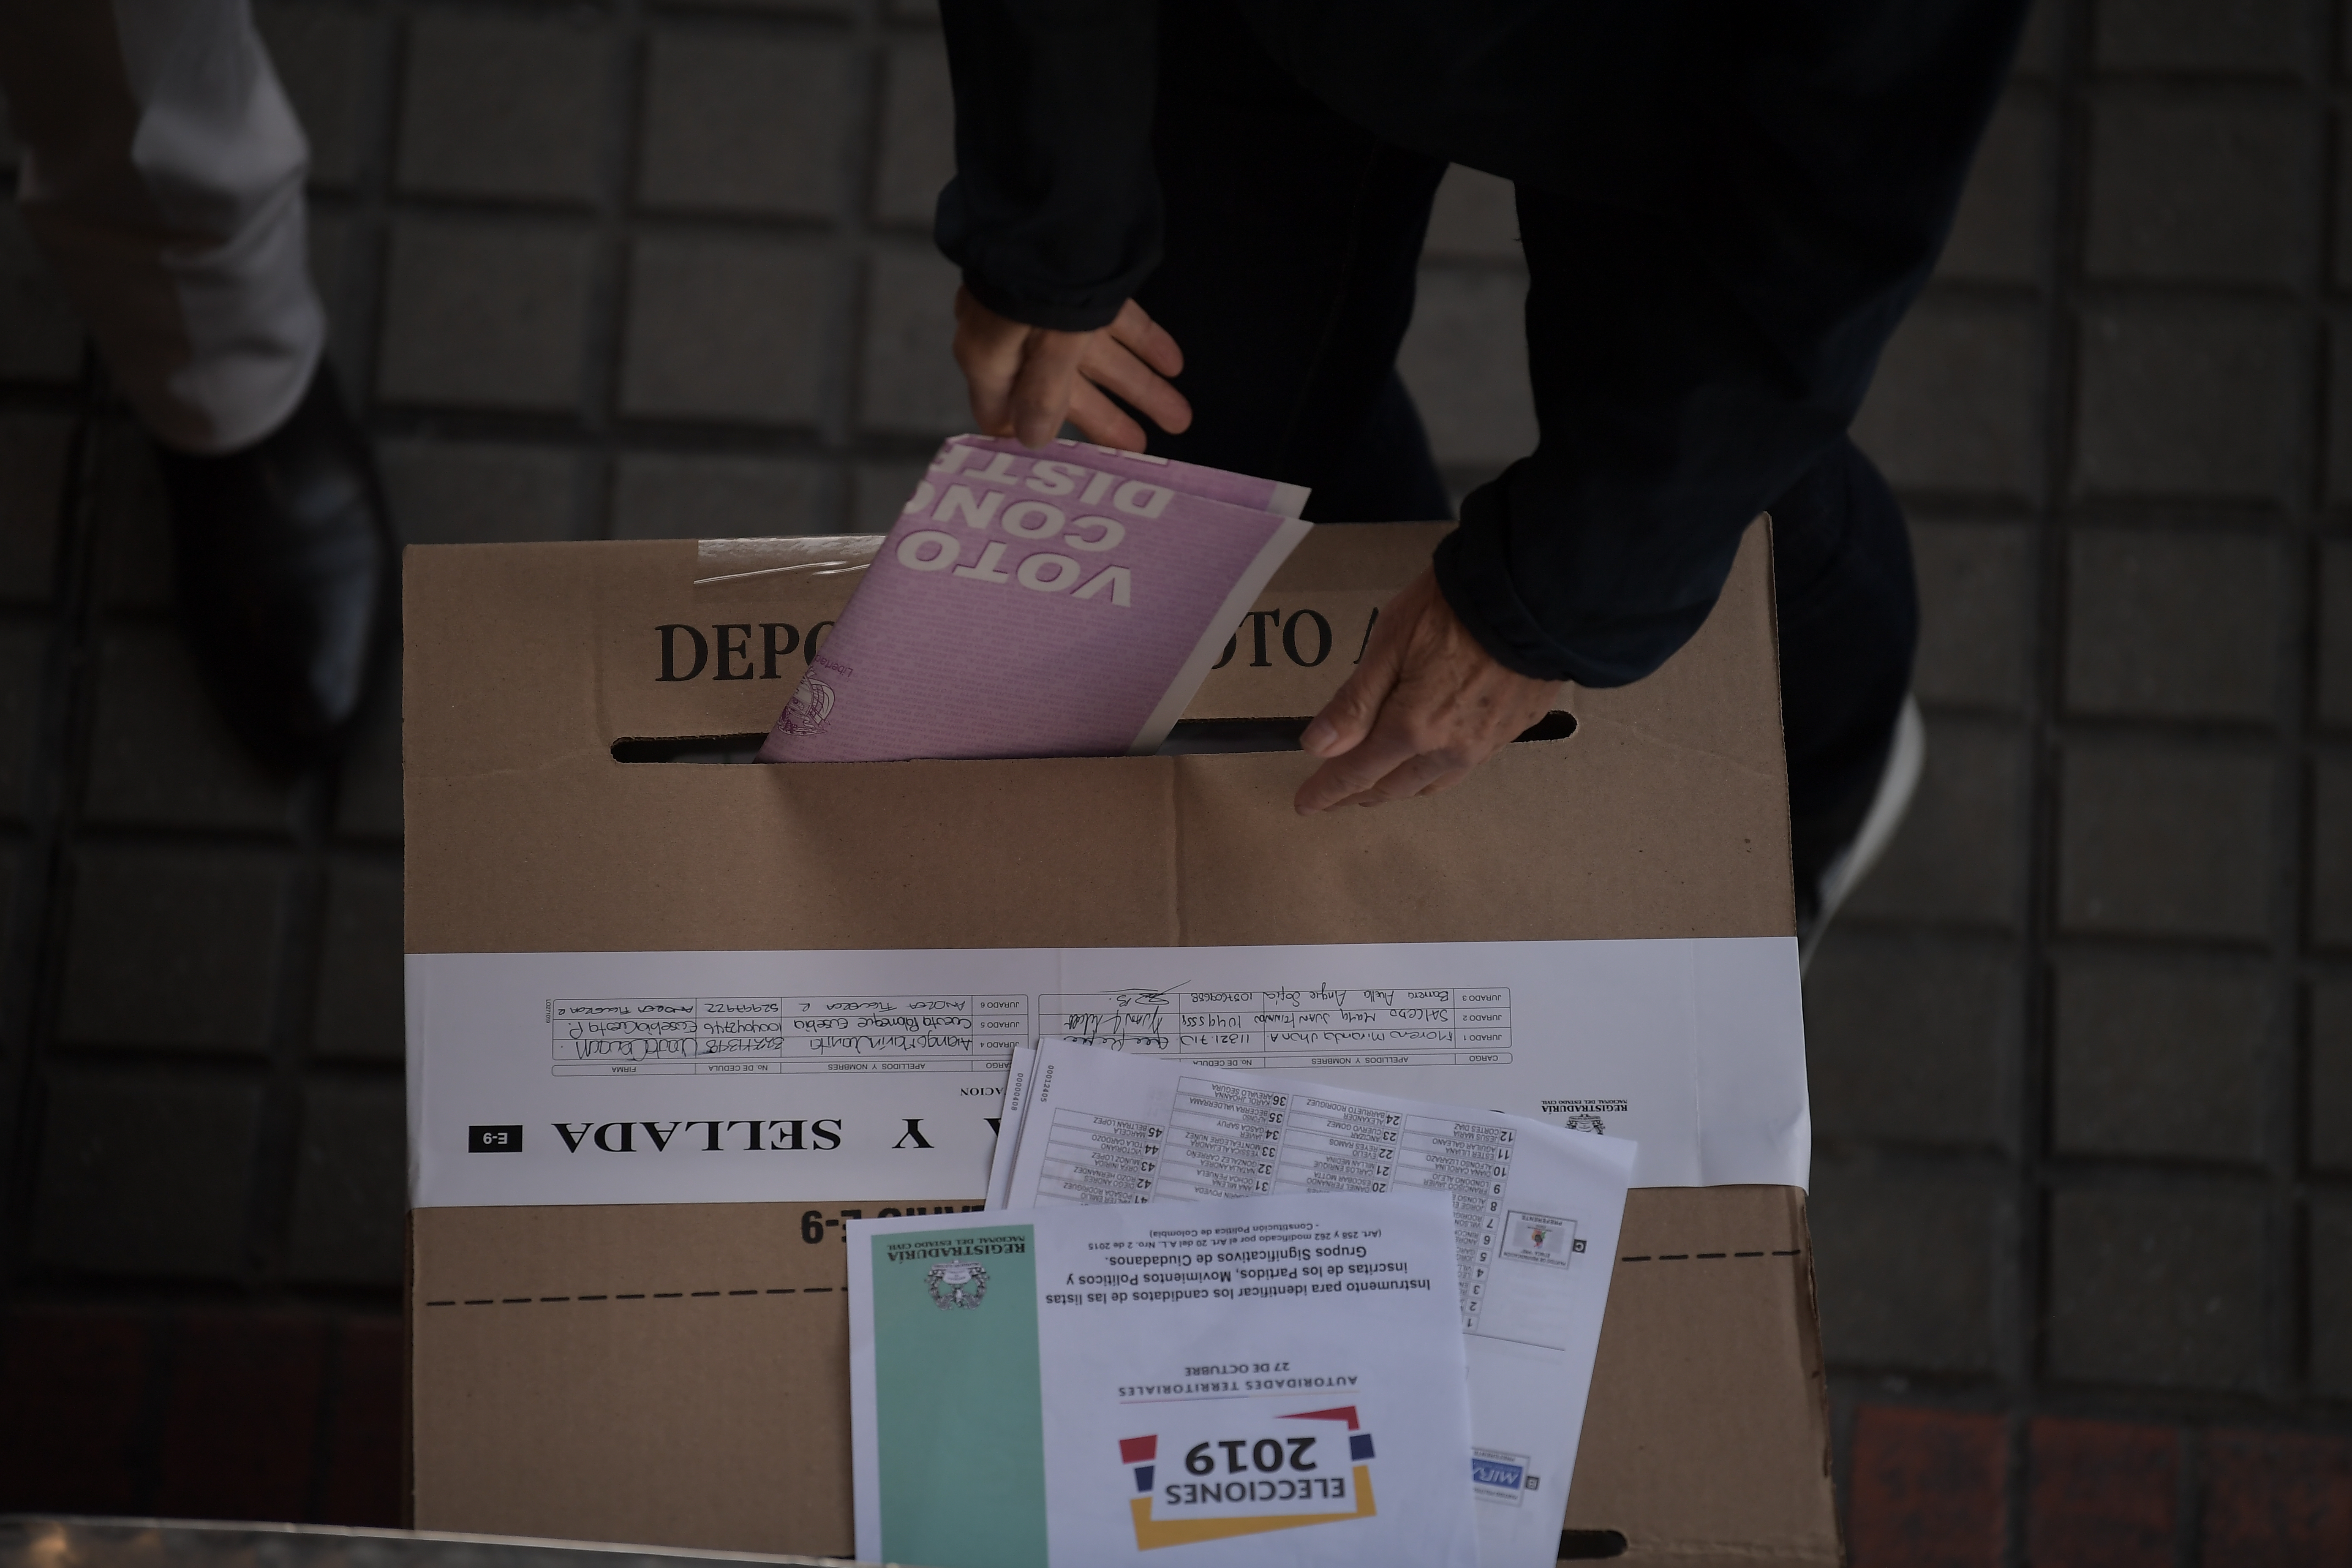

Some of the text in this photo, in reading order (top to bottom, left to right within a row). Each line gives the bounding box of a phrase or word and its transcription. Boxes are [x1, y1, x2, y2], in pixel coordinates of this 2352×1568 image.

[896, 529, 1130, 607] VOTO
[1211, 608, 1332, 669] TO
[961, 1088, 1005, 1096] ACION
[1273, 1096, 1286, 1106] 36
[1542, 1105, 1627, 1115] REGISTRADURÍA
[1269, 1113, 1282, 1123] 35
[1386, 1115, 1400, 1125] 24
[482, 1119, 933, 1154] Y SELLADA E-9
[1149, 1128, 1162, 1138] 45
[1265, 1130, 1279, 1140] 34
[1383, 1132, 1396, 1141] 23
[1500, 1132, 1513, 1142] 12
[1145, 1145, 1159, 1155] 44
[1262, 1146, 1275, 1157] 33
[1379, 1149, 1392, 1159] 22
[1498, 1149, 1510, 1159] 11
[1141, 1162, 1155, 1171] 43
[1258, 1164, 1272, 1174] 32
[1377, 1166, 1389, 1176] 21
[1494, 1167, 1506, 1177] 10
[1137, 1179, 1151, 1189] 42
[1255, 1181, 1268, 1191] 31
[1372, 1183, 1386, 1193] 20
[1494, 1184, 1500, 1194] 9
[1491, 1202, 1497, 1211] 8
[1486, 1219, 1494, 1228] 7
[1240, 1235, 1256, 1243] por
[1484, 1236, 1490, 1245] 6
[887, 1243, 1026, 1263] REGISTRADURÍA
[1105, 1245, 1367, 1267] Grupos Significativos de Ciudadanos.
[1480, 1252, 1487, 1261] 5
[1302, 1266, 1322, 1278] los
[1328, 1265, 1343, 1276] de
[1349, 1262, 1407, 1275] inscritas
[1477, 1269, 1484, 1277] 4
[1067, 1274, 1074, 1285] y
[1143, 1272, 1230, 1285] Movimientos
[1236, 1268, 1297, 1281] Partidos,
[1046, 1279, 1430, 1306] Instrumento para identificar los candidatos de las listas
[1474, 1285, 1480, 1294] 3
[1470, 1302, 1477, 1311] 2
[1467, 1318, 1472, 1327] 1
[1184, 1363, 1289, 1376] 27 DE OCTUBRE
[1118, 1376, 1358, 1396] AUTORIDADES TERRITORIALES
[1186, 1437, 1317, 1475] 2019
[1166, 1478, 1344, 1505] ELECCIONES
